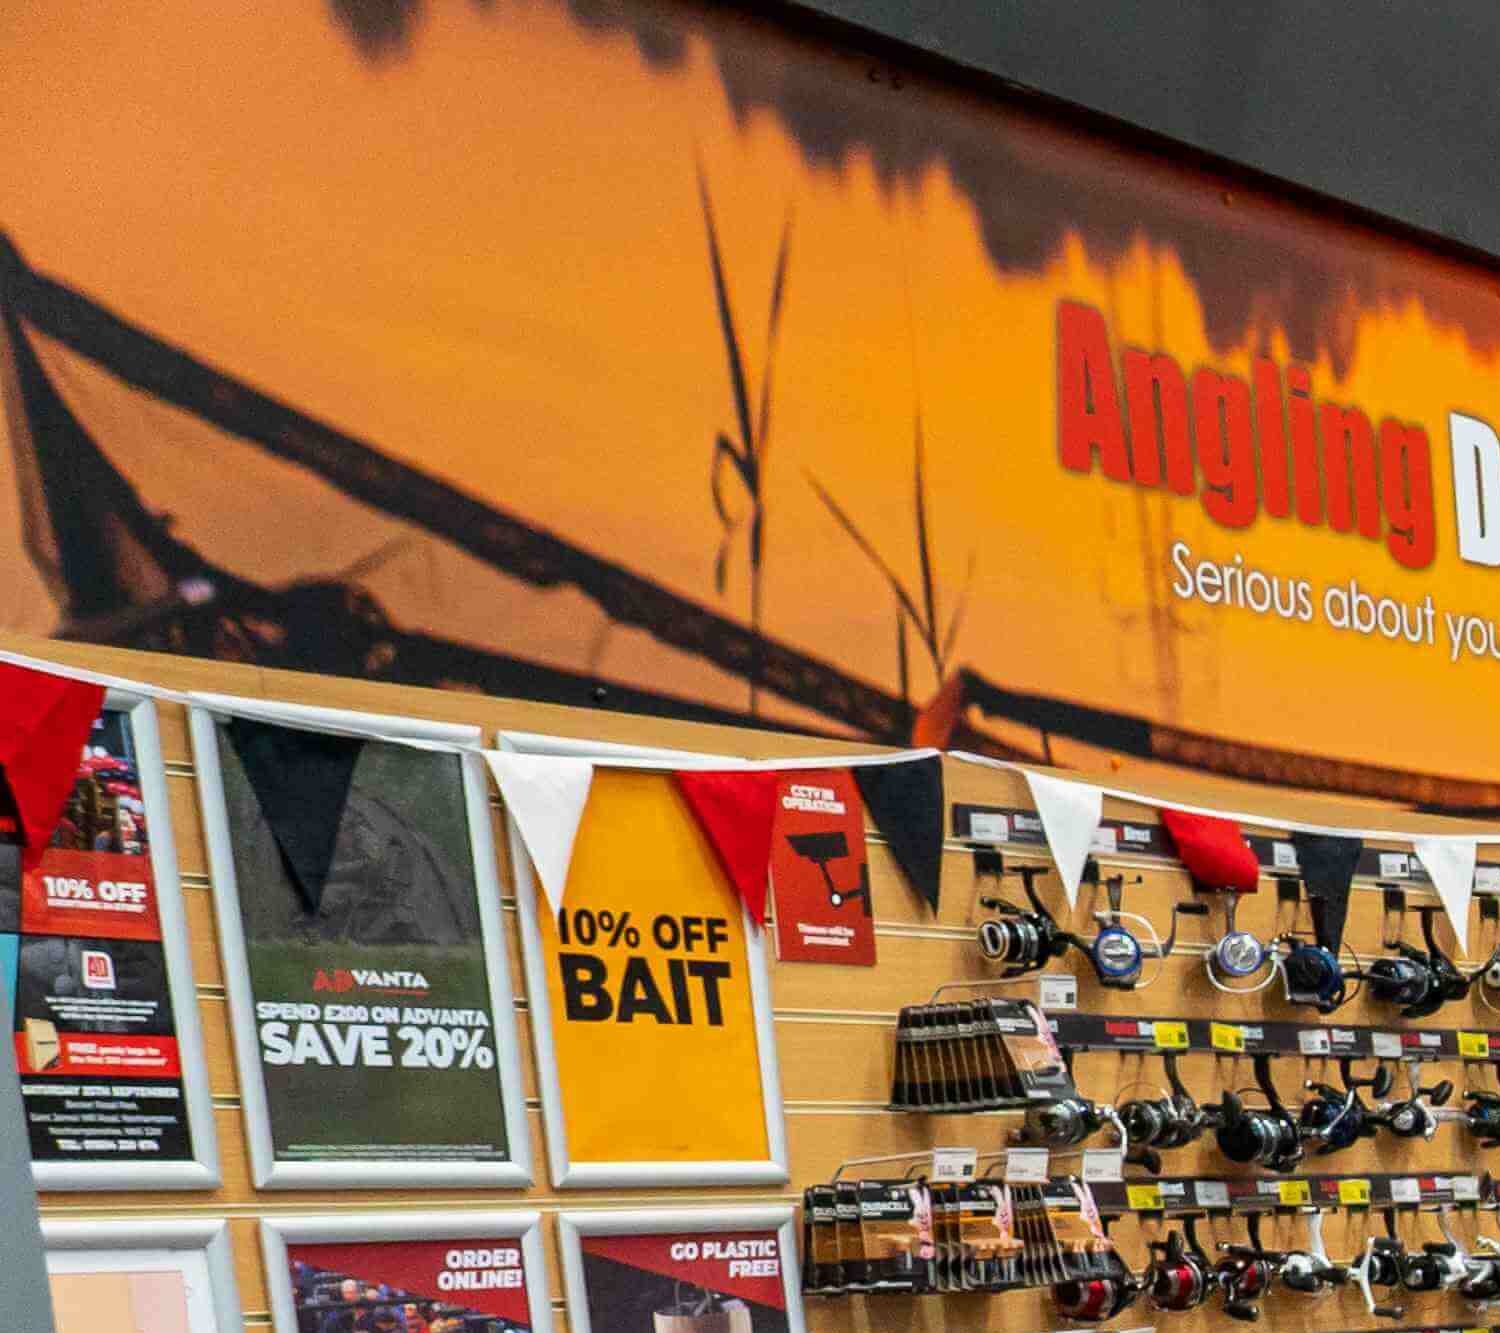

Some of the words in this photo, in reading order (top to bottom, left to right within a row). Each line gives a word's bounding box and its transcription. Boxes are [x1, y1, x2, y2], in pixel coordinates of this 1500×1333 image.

[1055, 298, 1436, 571] Angling
[1171, 540, 1313, 621] Serious
[1324, 580, 1434, 645] about
[42, 875, 93, 899] 10%
[98, 882, 147, 902] OFF
[559, 907, 640, 948] 10%
[652, 914, 729, 953] OFF
[312, 968, 430, 992] ADVANTA
[558, 951, 731, 1026] BAIT
[257, 1002, 320, 1020] SPEND
[371, 1006, 398, 1024] ON
[400, 1008, 488, 1026] ADVANTA
[260, 1022, 392, 1067] SAVE
[398, 1025, 495, 1069] 20%
[446, 1248, 520, 1268] ORDER
[670, 1243, 696, 1260] GO
[702, 1240, 777, 1258] PLASTIC
[437, 1270, 523, 1291] ONLINE!
